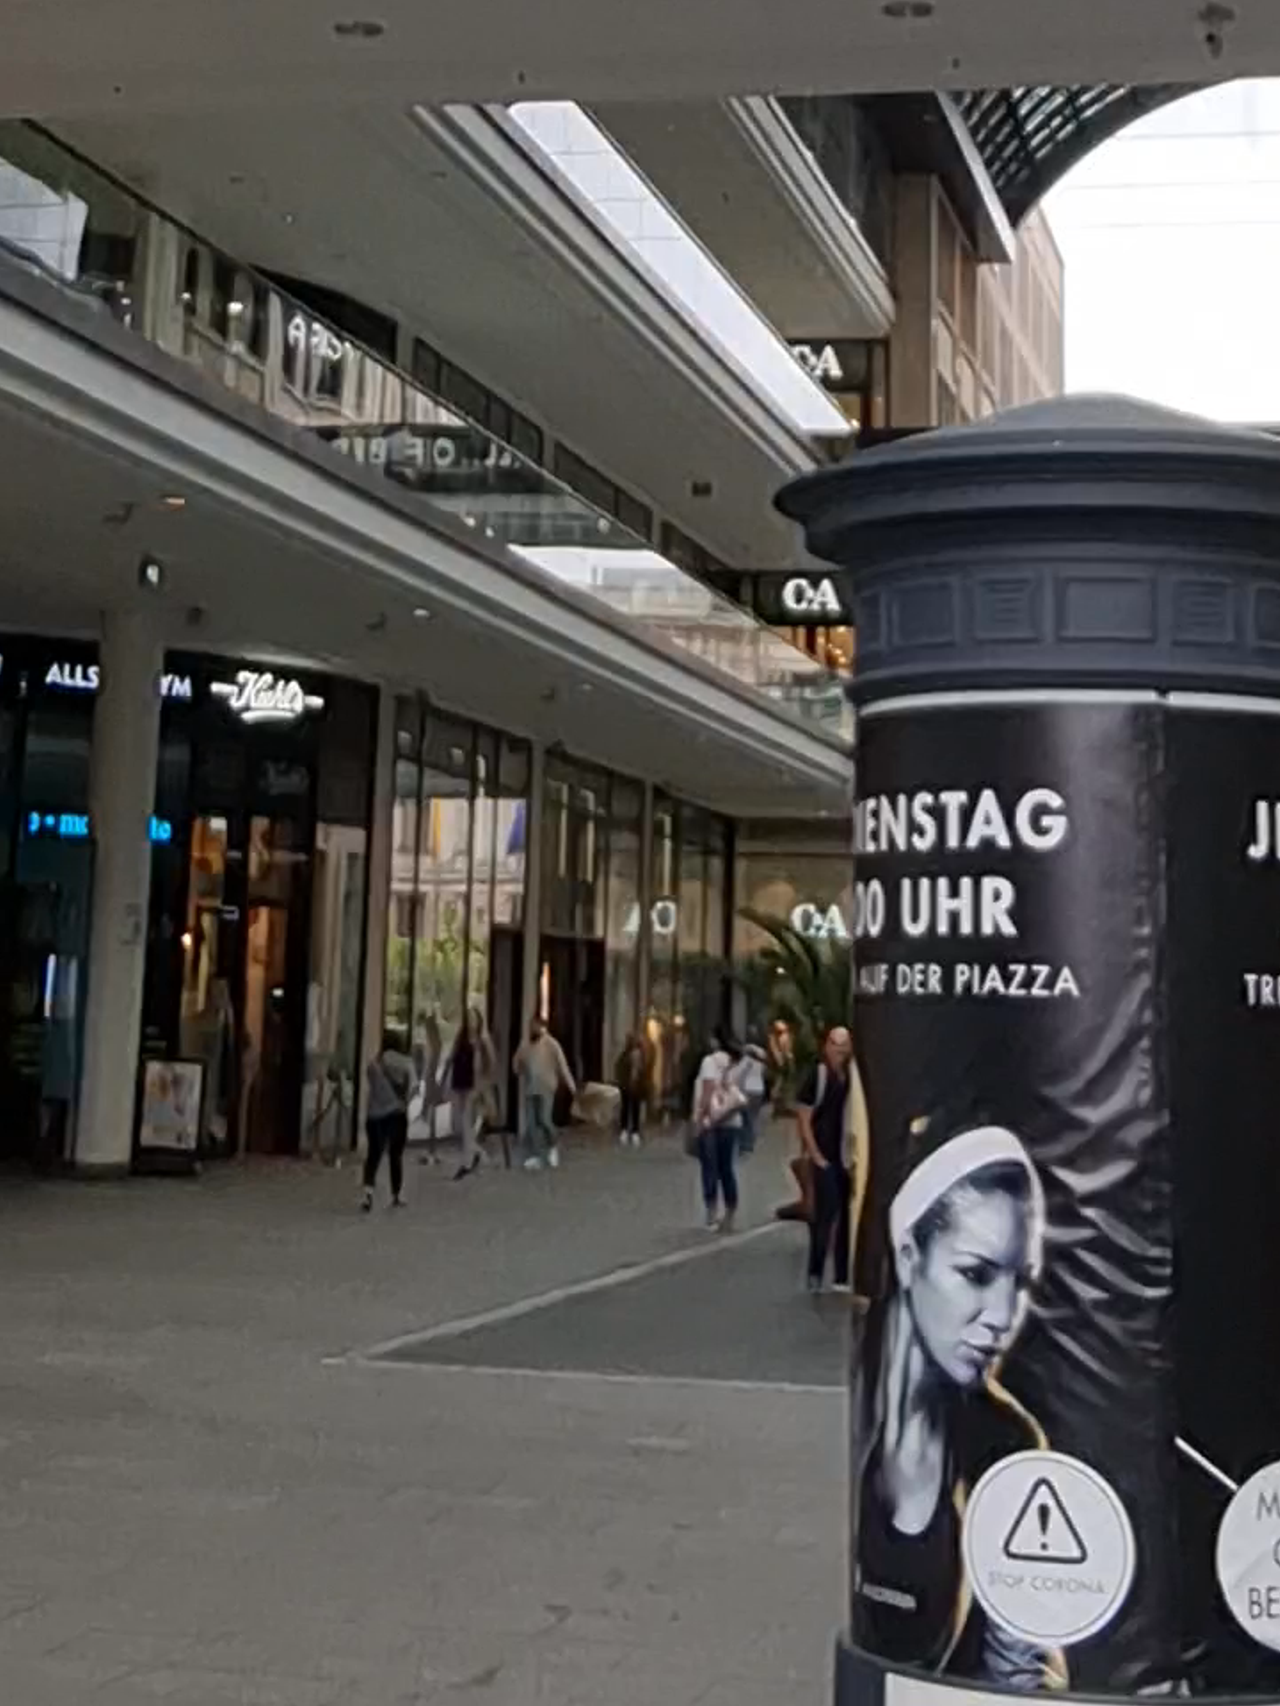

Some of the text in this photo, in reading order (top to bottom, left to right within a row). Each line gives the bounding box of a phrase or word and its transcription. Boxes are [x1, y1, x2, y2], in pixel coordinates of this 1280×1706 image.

[900, 875, 1019, 937] UHR
[895, 962, 943, 995] DER
[953, 963, 1081, 997] PIAZZA
